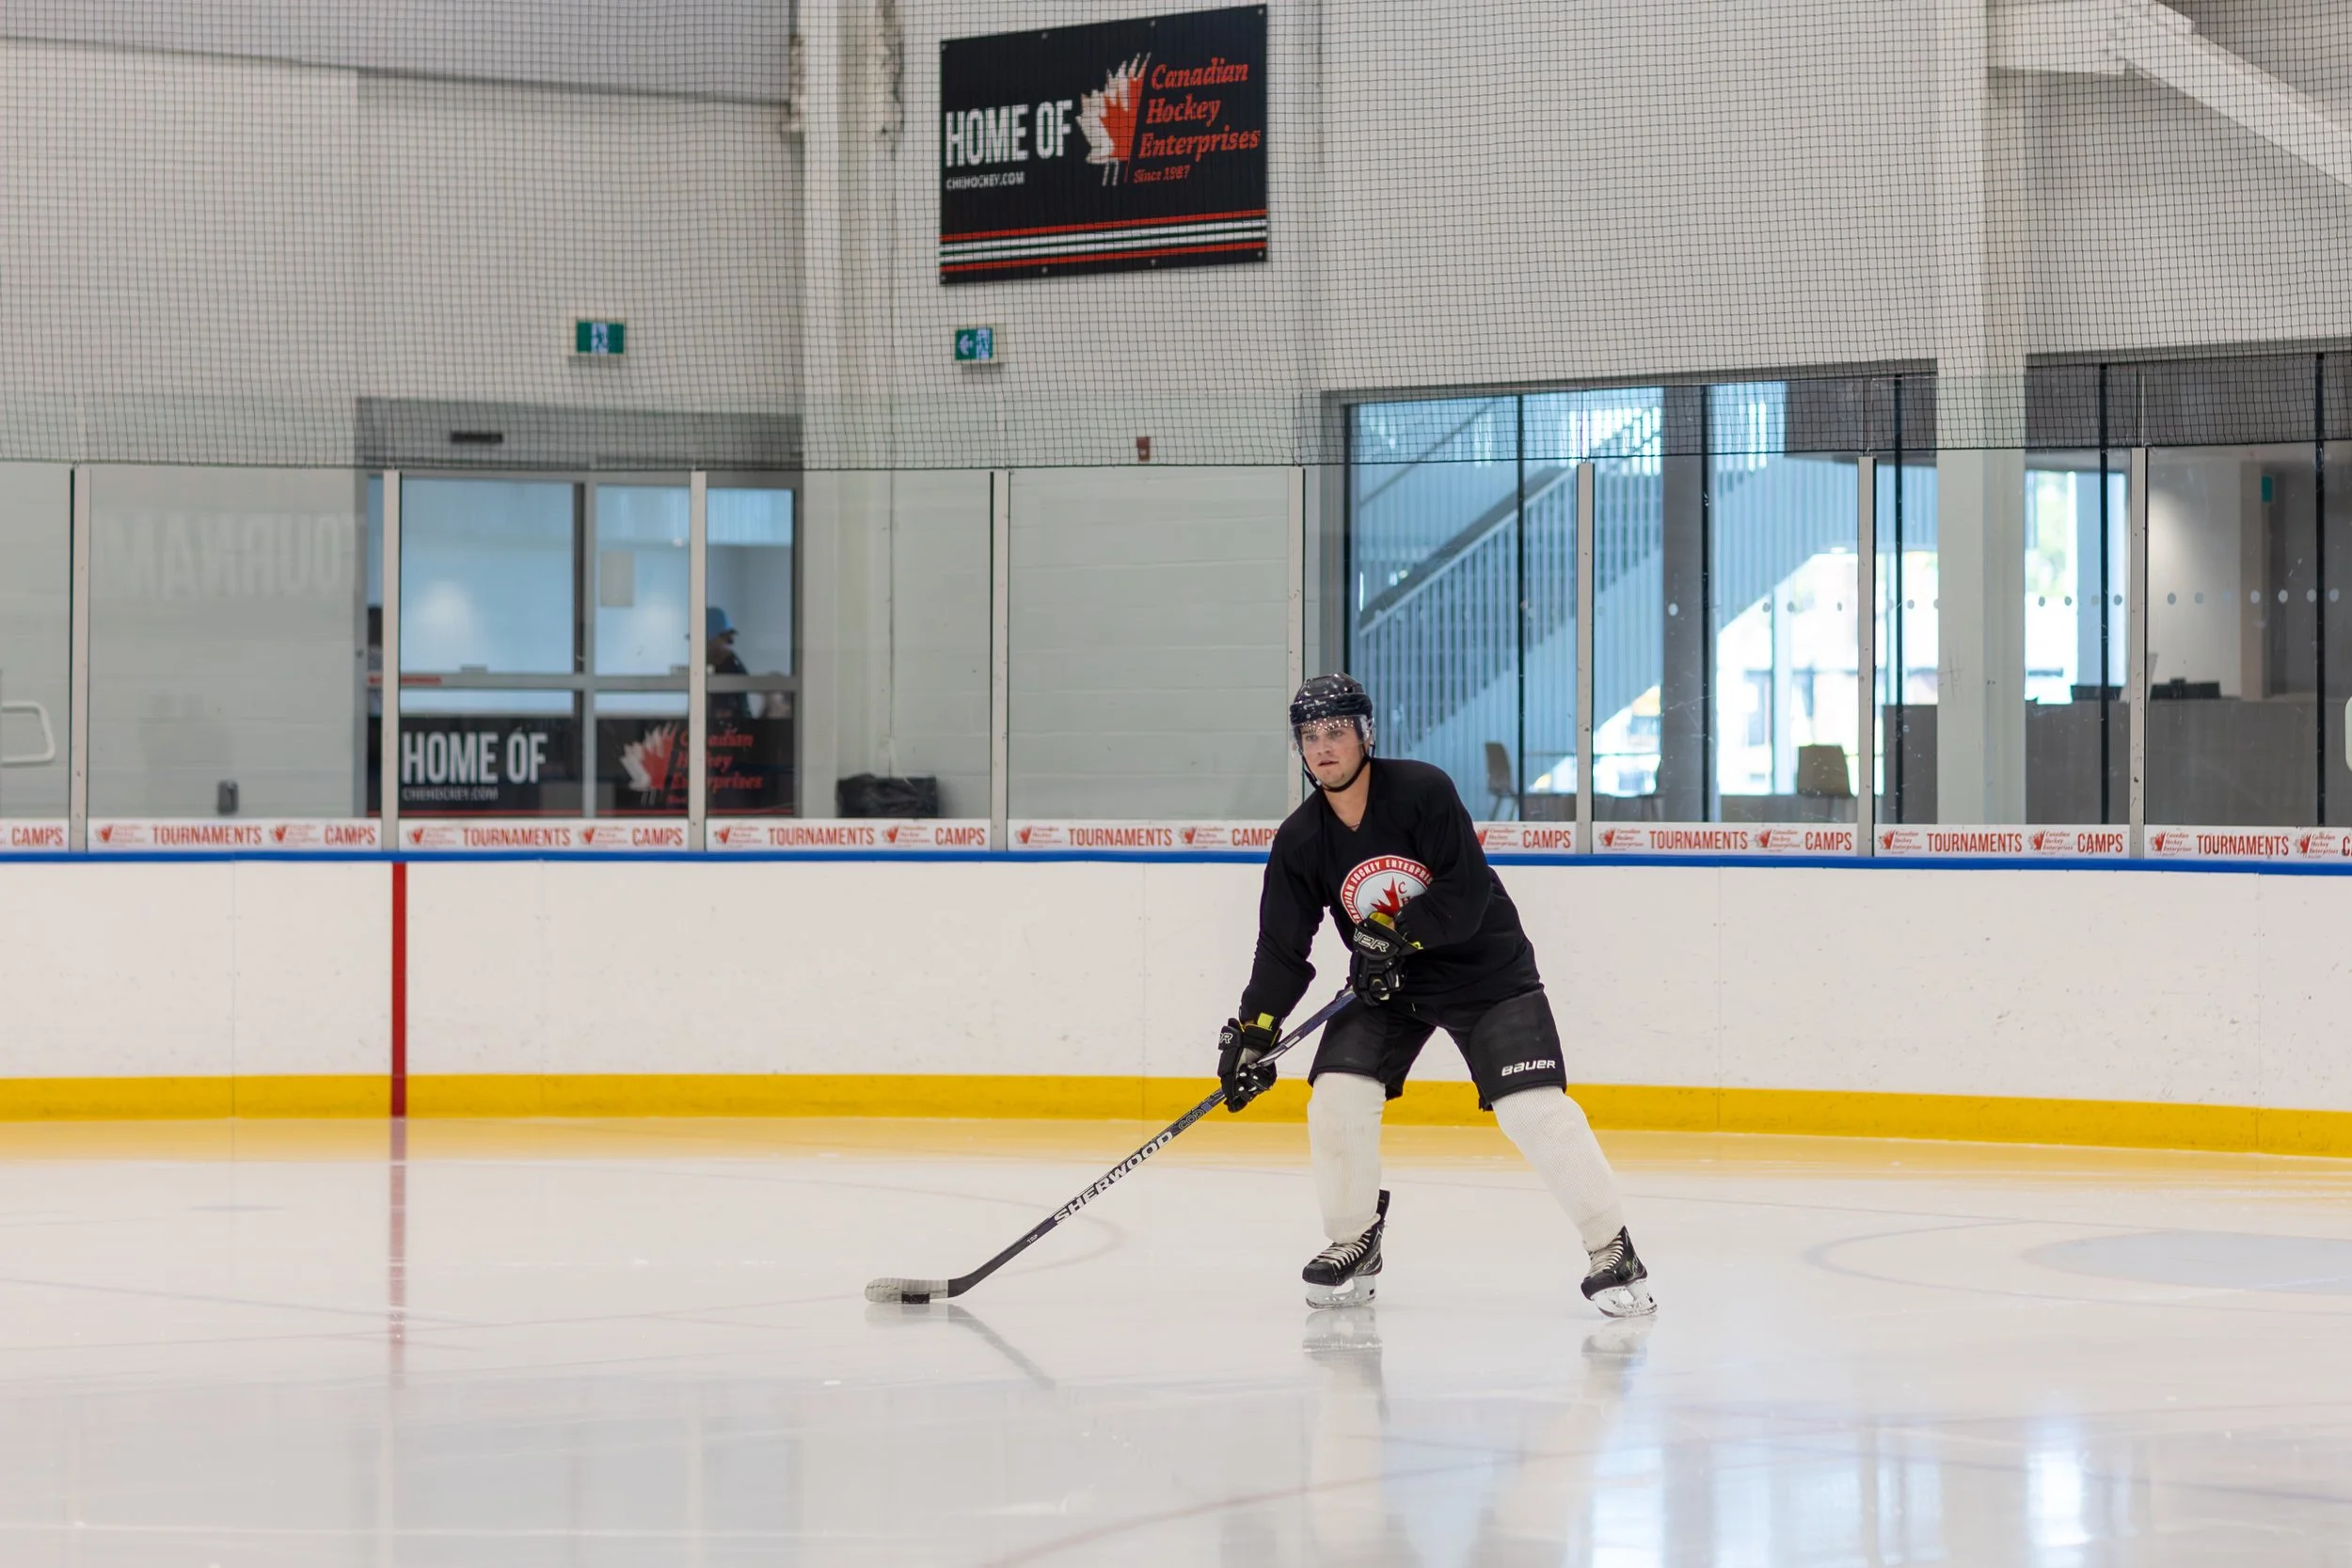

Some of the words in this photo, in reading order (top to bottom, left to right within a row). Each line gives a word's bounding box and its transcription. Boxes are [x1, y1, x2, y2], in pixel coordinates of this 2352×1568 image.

[1151, 56, 1248, 90] Canadian
[1146, 93, 1221, 128] Hockey
[946, 104, 1029, 167] HOME
[1037, 100, 1073, 159] OF
[1138, 124, 1262, 163] Enterprises
[1133, 167, 1161, 184] Since
[1163, 164, 1191, 182] 1987
[403, 731, 499, 784] HOME
[506, 731, 548, 784] OF
[11, 826, 63, 846] CAMPS
[152, 825, 262, 846] TOURNAMENTS
[325, 825, 375, 846] CAMPS
[463, 827, 571, 846] TOURNAMENTS
[631, 827, 683, 847] CAMPS
[768, 827, 874, 846] TOURNAMENTS
[934, 827, 985, 846] CAMPS
[1068, 828, 1172, 846] TOURNAMENTS
[1522, 830, 1571, 848] CAMPS
[1649, 831, 1747, 850] TOURNAMENTS
[1804, 832, 1852, 850] CAMPS
[1927, 832, 2023, 852] TOURNAMENTS
[2077, 833, 2123, 853] CAMPS
[2196, 834, 2289, 856] TOURNAMENTS
[1054, 1131, 1173, 1223] SHERWOOD
